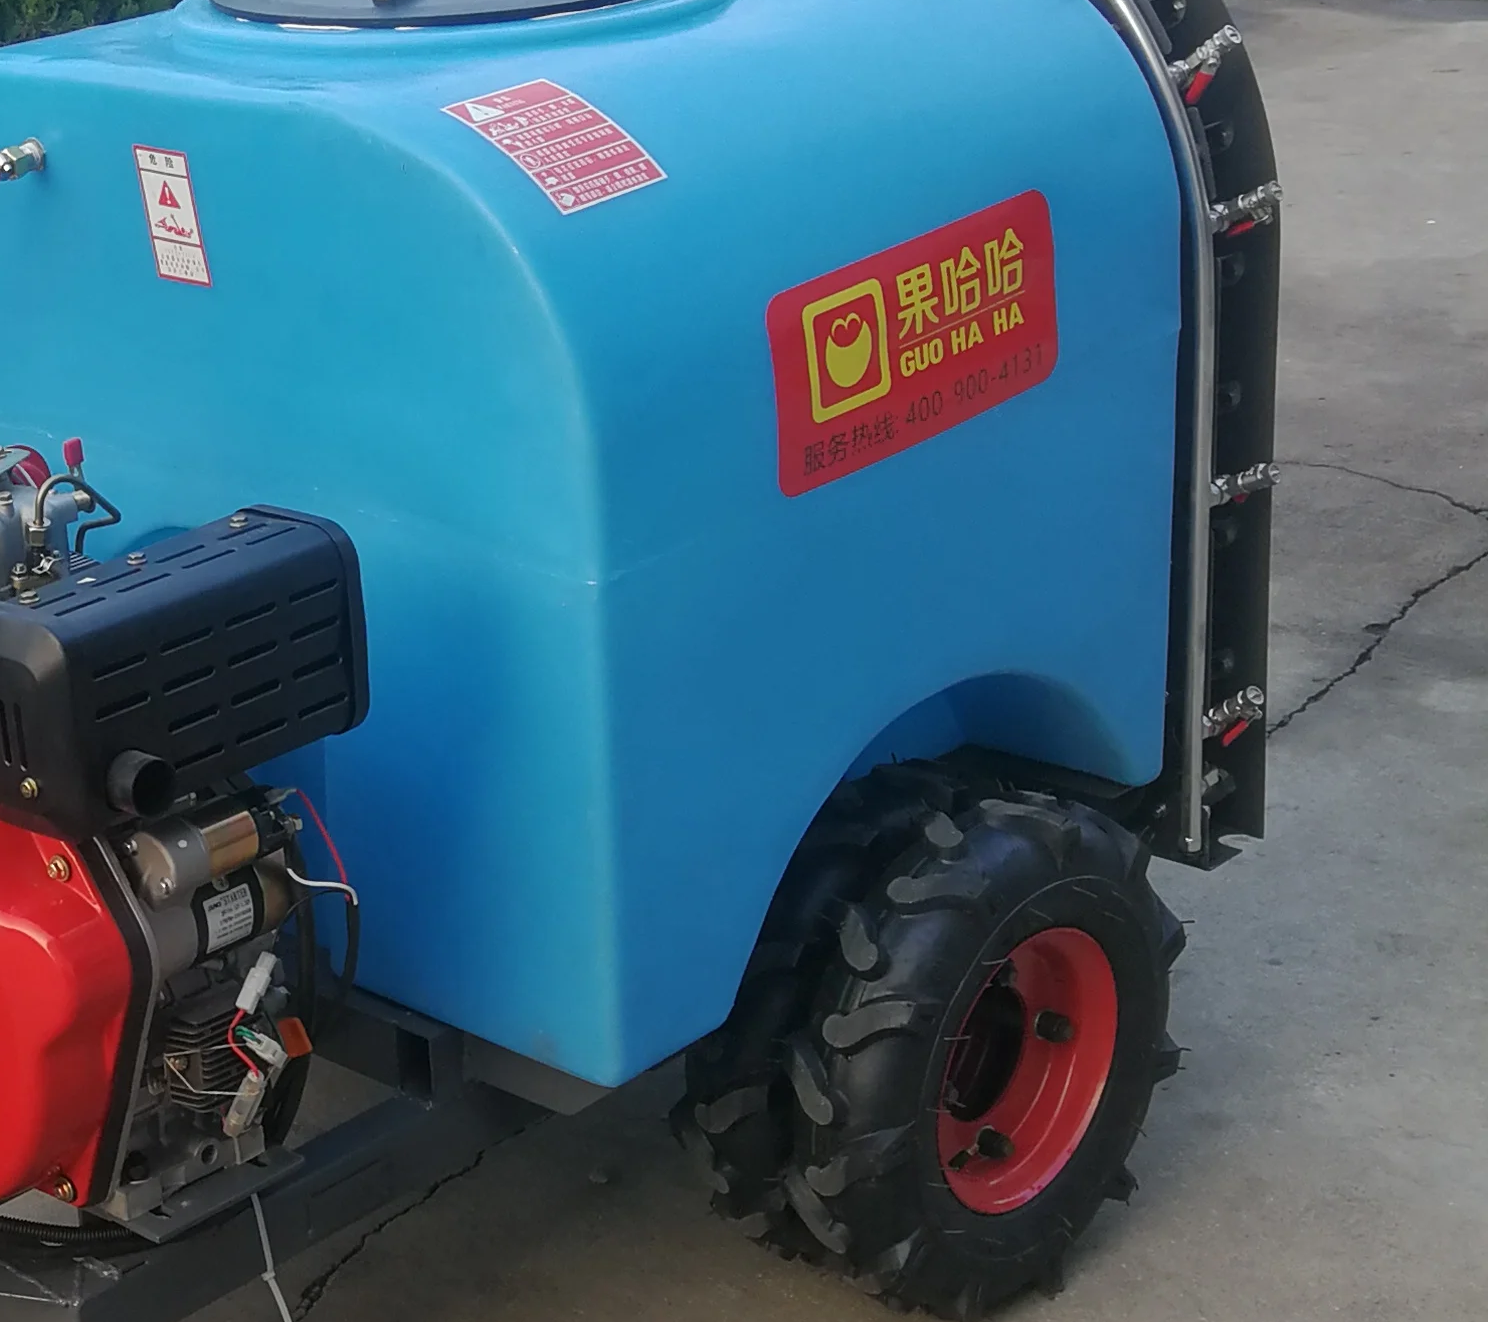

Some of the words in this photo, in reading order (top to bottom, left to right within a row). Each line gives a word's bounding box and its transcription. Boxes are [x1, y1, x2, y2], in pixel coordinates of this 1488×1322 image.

[895, 228, 1024, 339] 果哈哈
[899, 338, 944, 378] GUO
[951, 320, 984, 356] HA
[993, 301, 1025, 336] HA
[905, 390, 943, 425] 400
